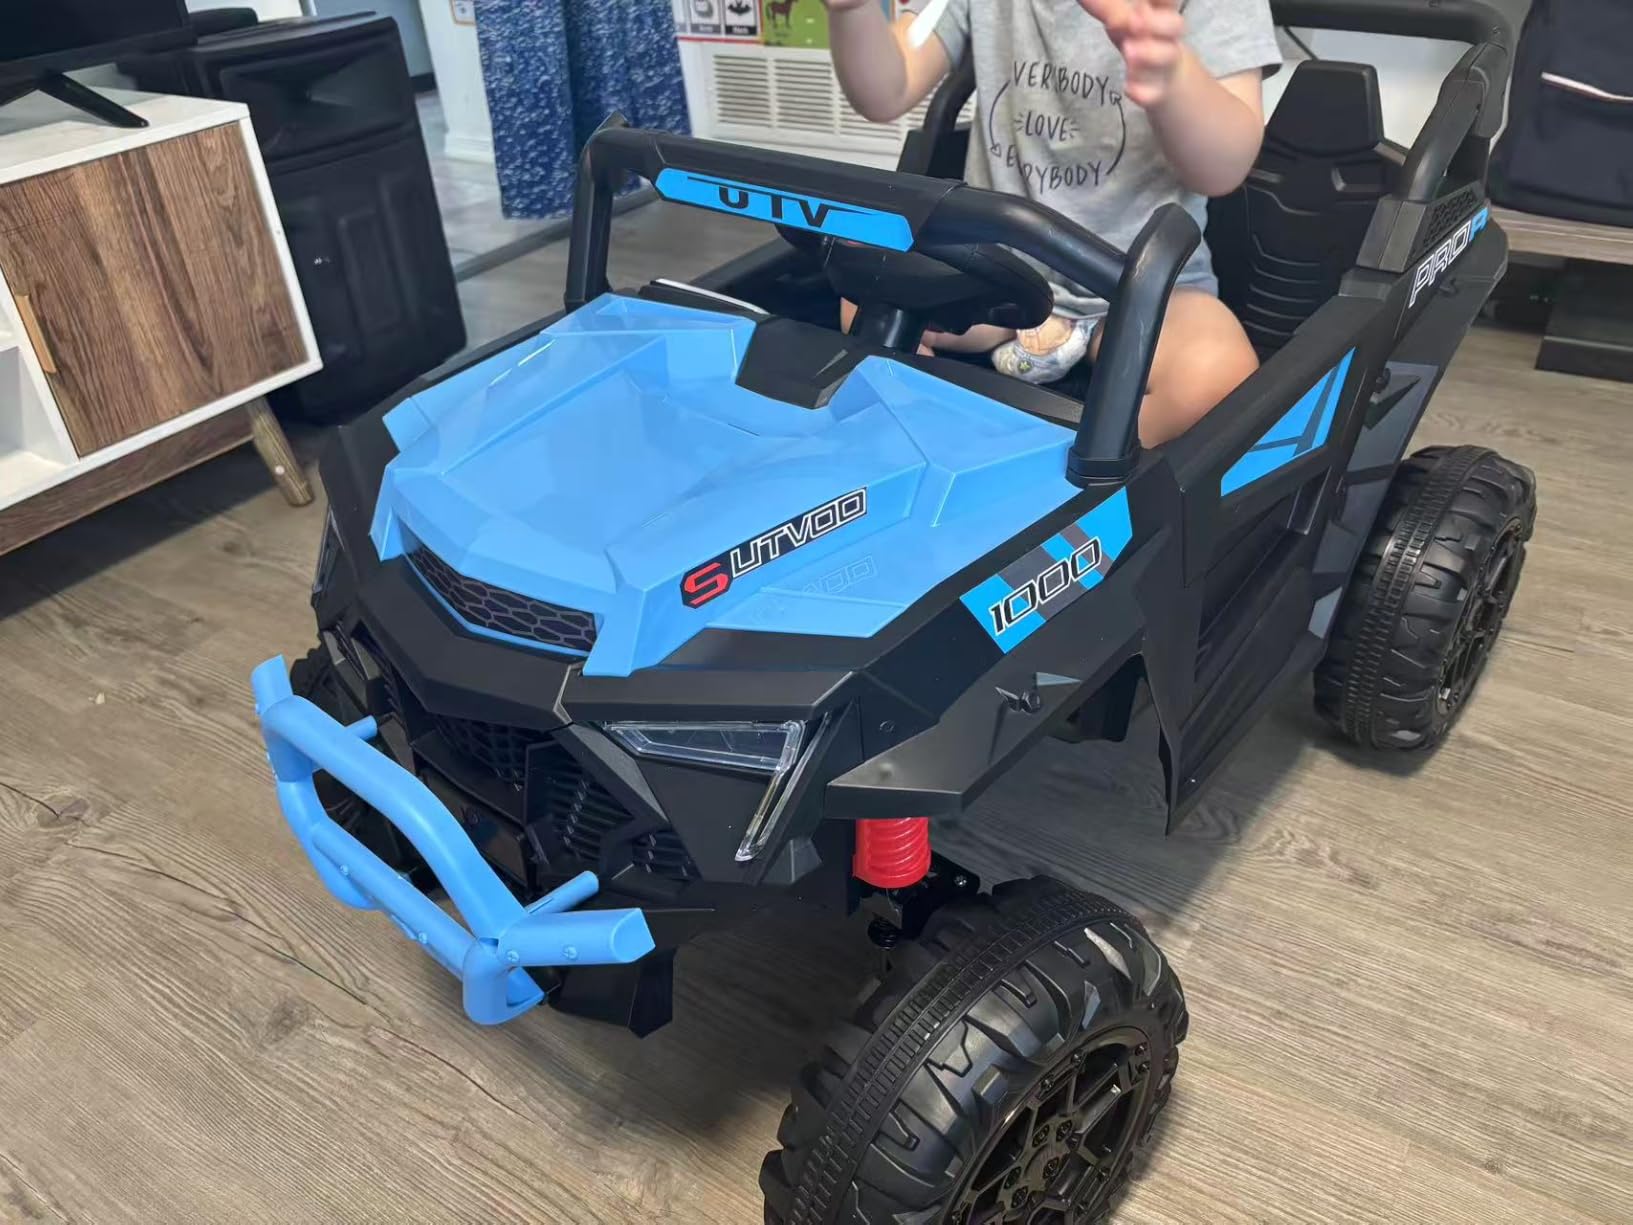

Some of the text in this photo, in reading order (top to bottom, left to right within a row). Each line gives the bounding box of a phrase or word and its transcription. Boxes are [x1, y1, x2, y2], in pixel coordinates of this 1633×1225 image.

[1025, 110, 1071, 141] LOVE
[718, 186, 831, 228] UTV
[988, 536, 1102, 636] 1000
